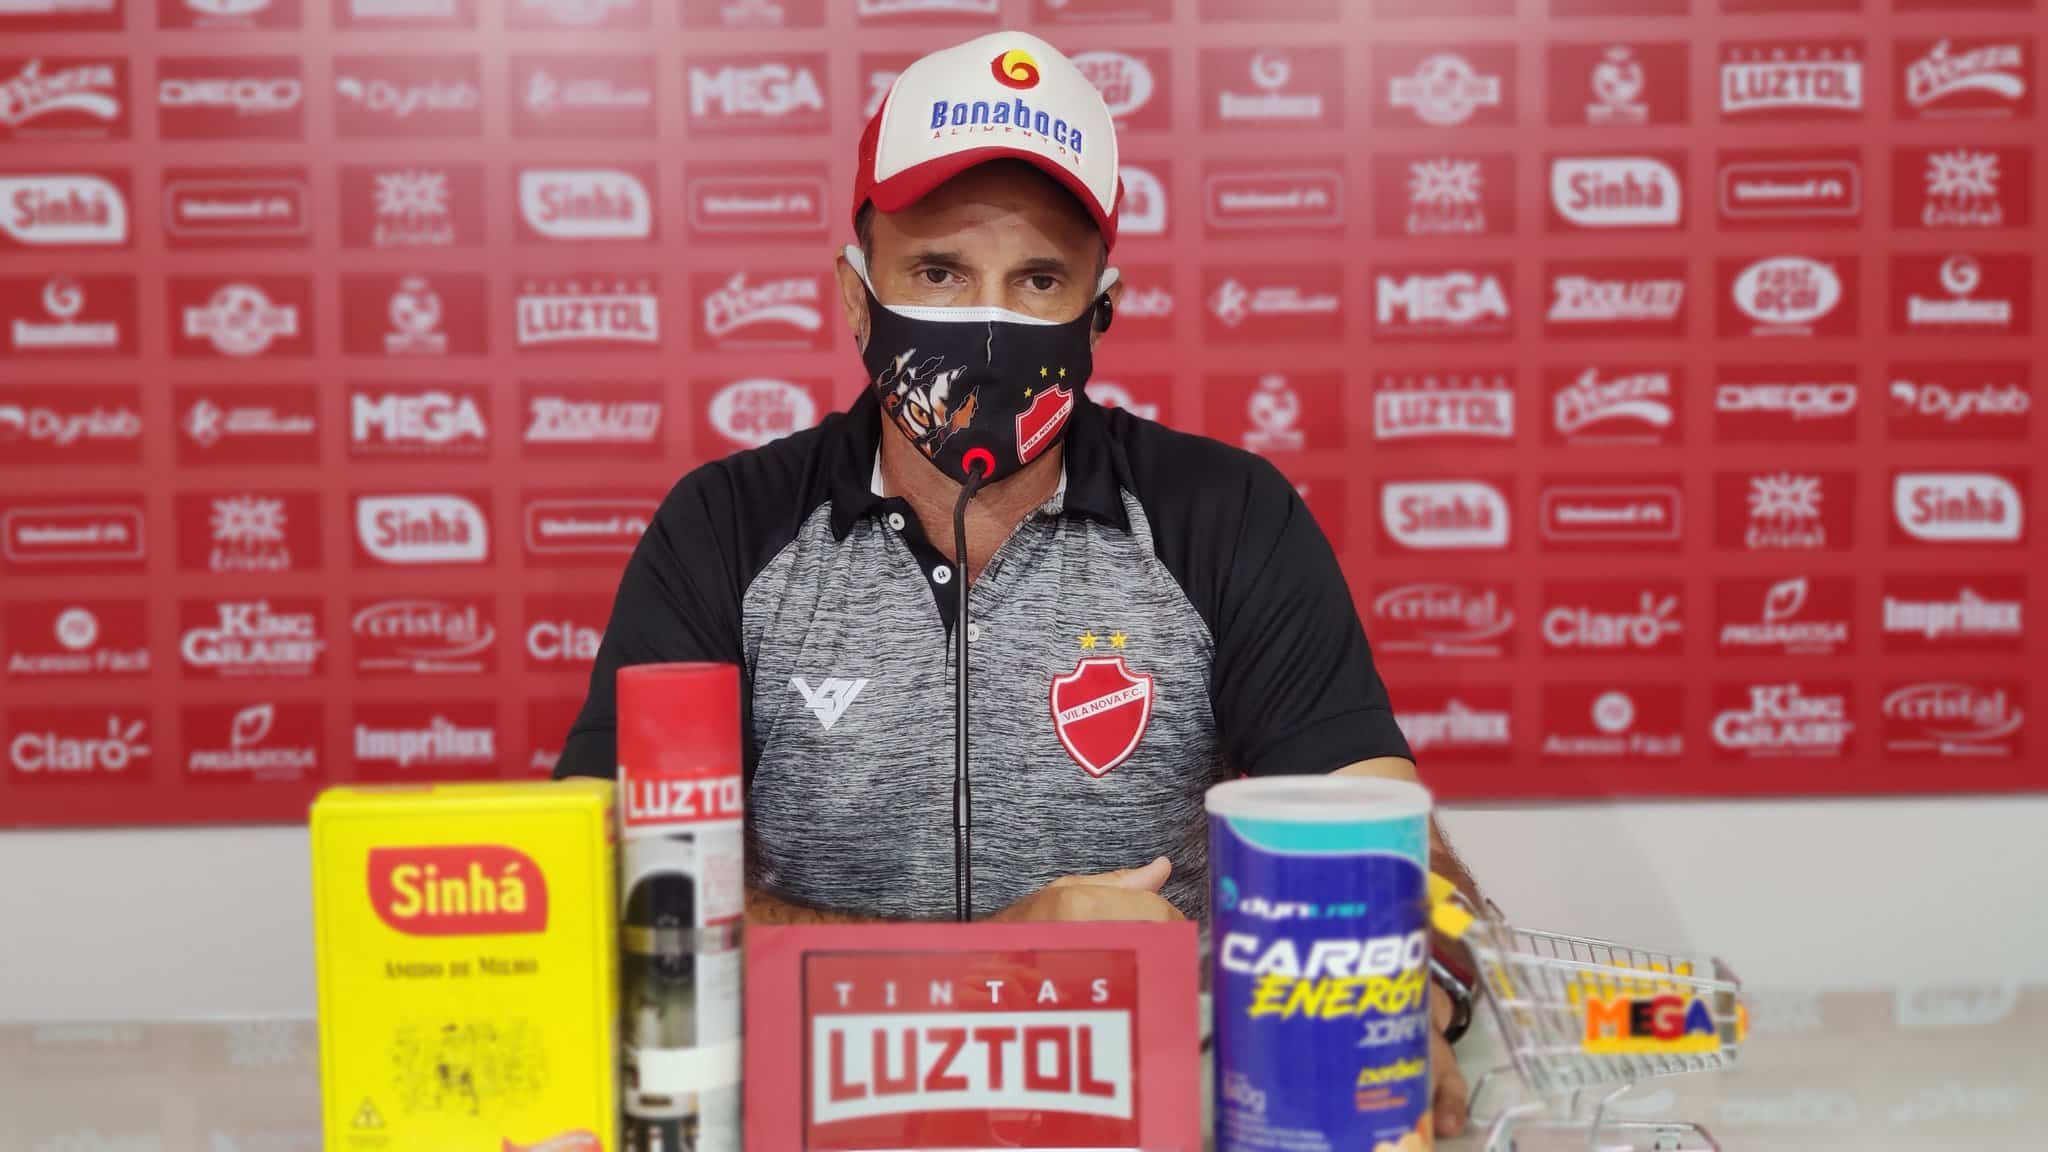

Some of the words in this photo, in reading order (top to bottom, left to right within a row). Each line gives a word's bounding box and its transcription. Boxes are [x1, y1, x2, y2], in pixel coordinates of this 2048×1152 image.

[687, 63, 823, 116] MEGA
[1727, 67, 1854, 103] LUZTOL
[930, 98, 1084, 154] Bonaboca
[1569, 170, 1665, 212] Sinhá
[526, 301, 649, 336] LUZTOL
[1376, 271, 1508, 324] MEGA
[352, 391, 486, 443] MEGA
[1380, 395, 1505, 431] LUZTOL
[1920, 383, 2031, 421] Dynlab
[29, 407, 143, 445] Dynlab
[1399, 493, 1494, 534] Sinhá
[1911, 484, 2007, 526] Sinhá
[373, 508, 470, 548] Sinhá
[526, 619, 601, 661] Cla
[1541, 605, 1662, 647] Claro
[1063, 708, 1089, 722] VILA
[1090, 694, 1123, 713] NOVA
[9, 732, 130, 772] Claro
[628, 776, 743, 820] LUZTO
[390, 861, 527, 918] Sinhá
[1220, 930, 1427, 979] CARBO
[834, 978, 1109, 1007] TINTAS
[1248, 968, 1428, 1020] ENERGY
[1586, 994, 1716, 1041] MEGA
[829, 1024, 1116, 1103] LUZTOL
